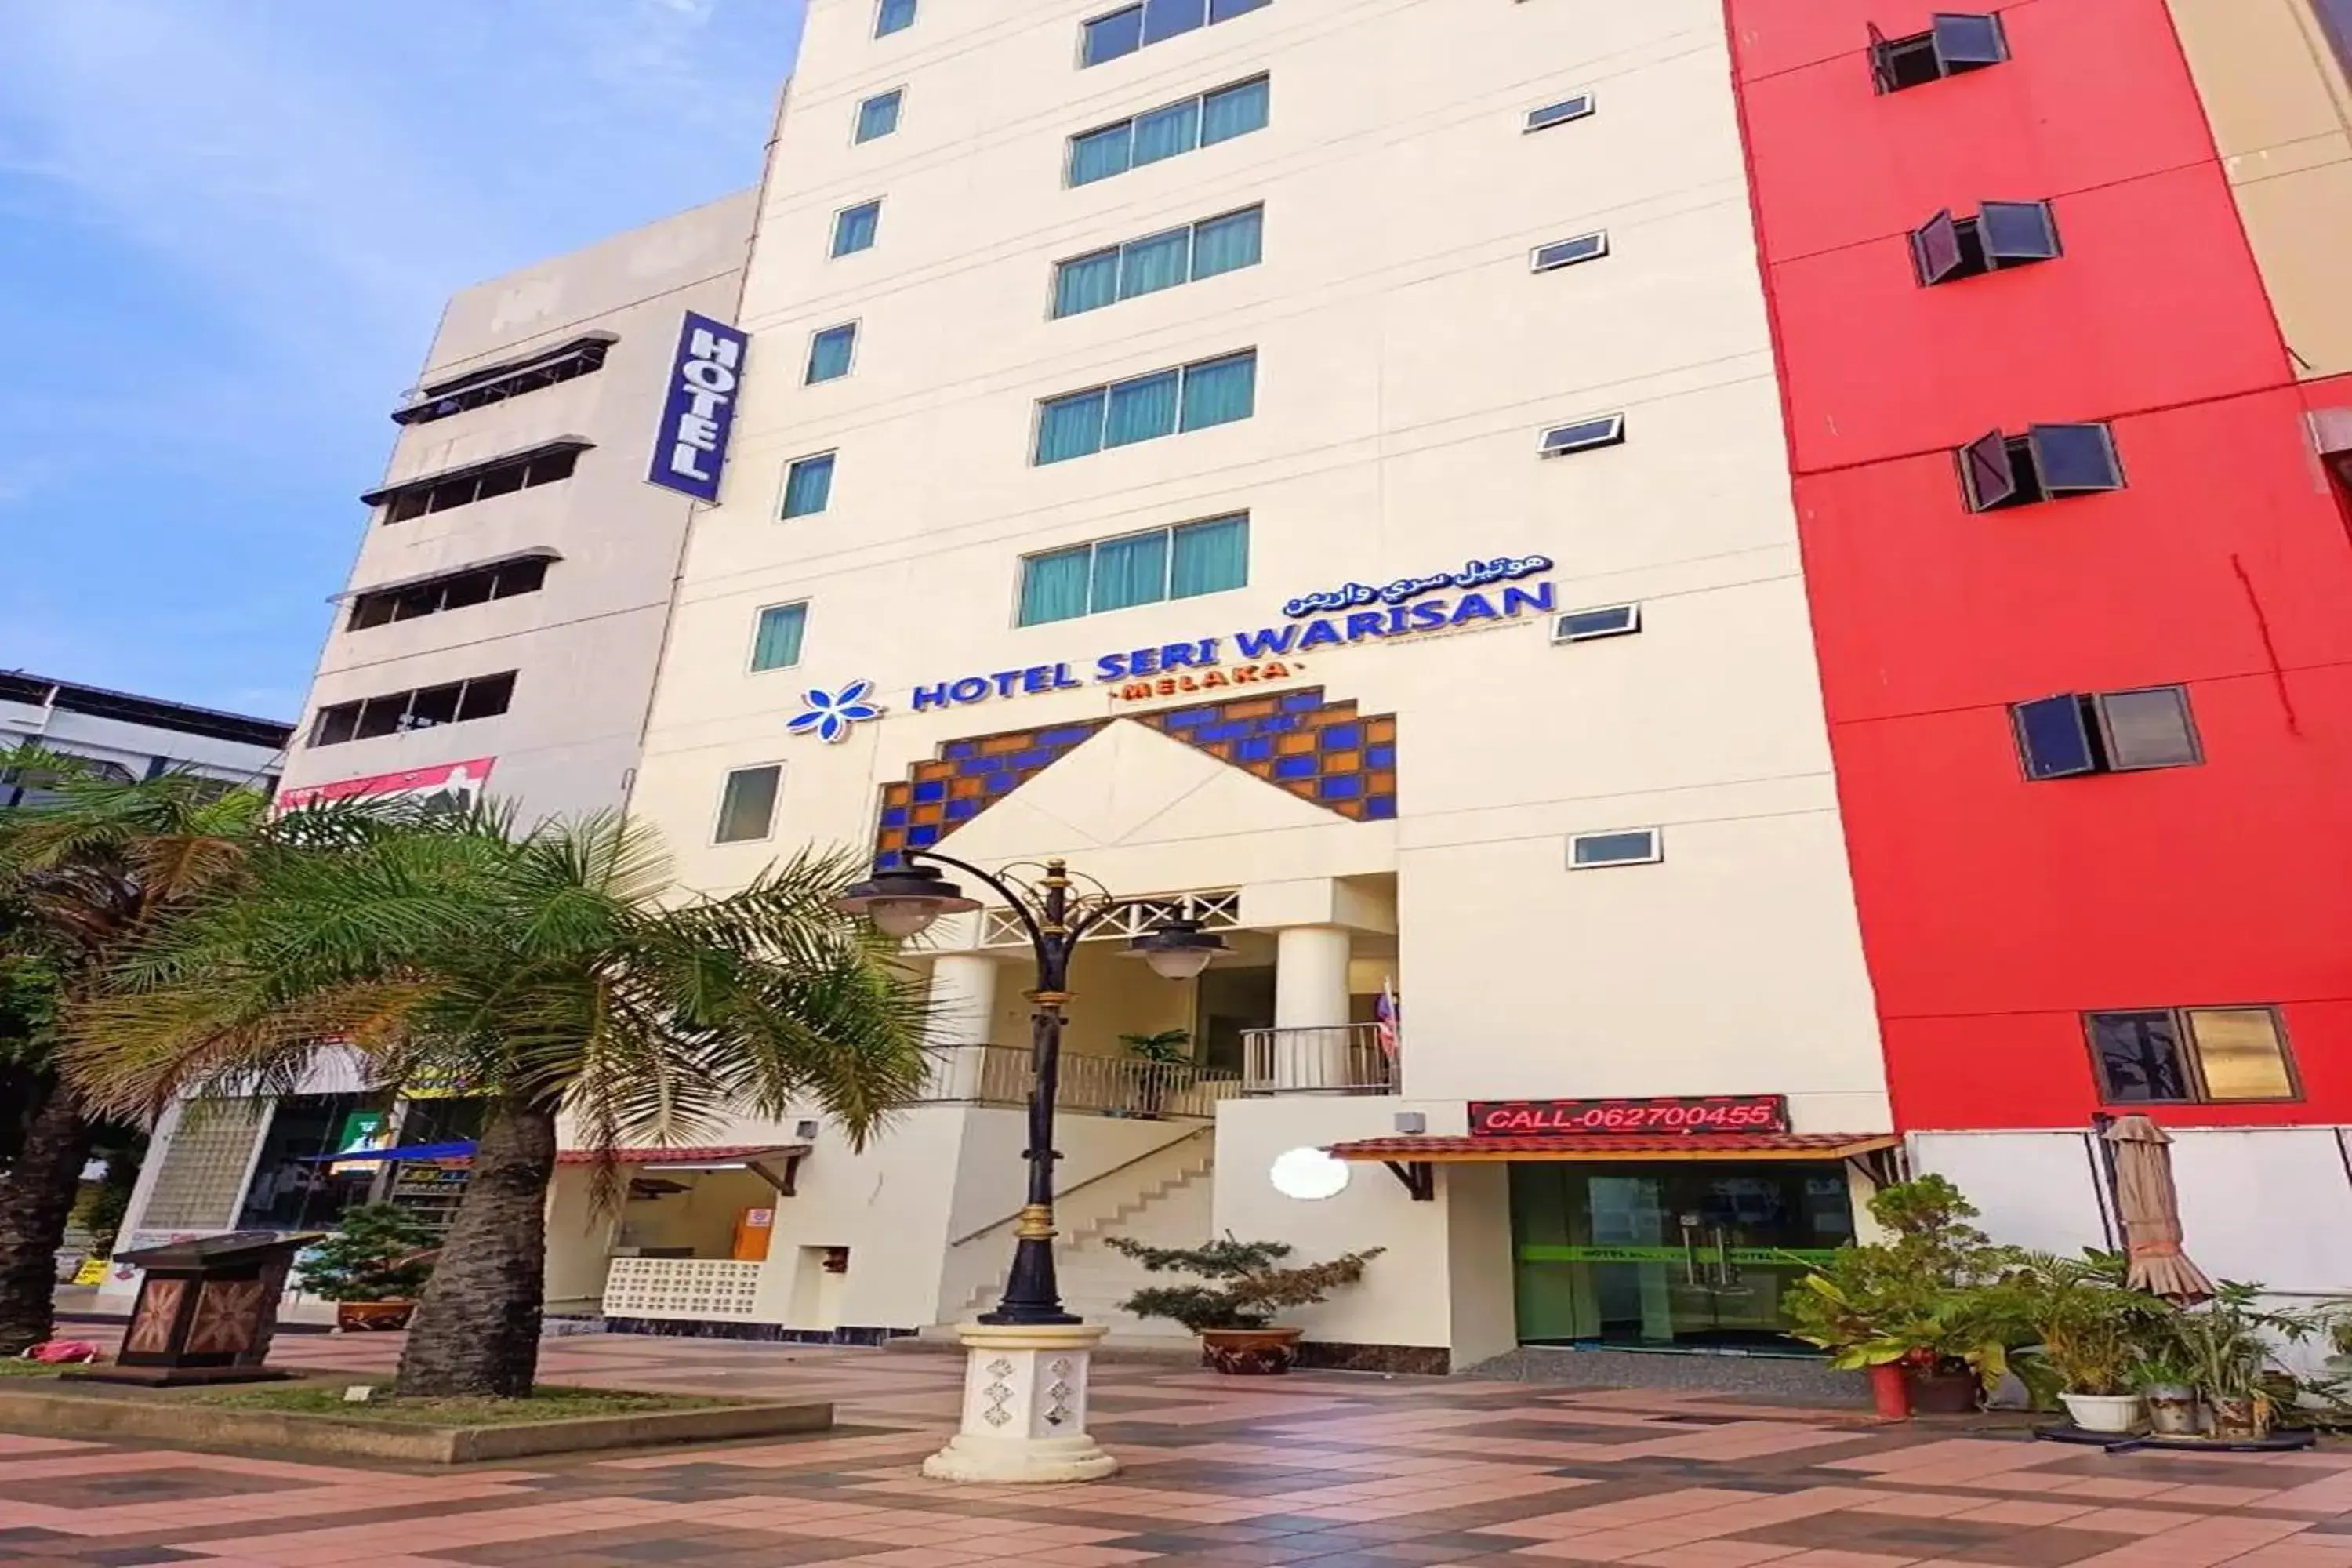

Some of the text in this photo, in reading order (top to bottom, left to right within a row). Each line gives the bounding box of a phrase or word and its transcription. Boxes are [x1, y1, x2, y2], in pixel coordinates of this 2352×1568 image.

[670, 328, 739, 481] HOTEL
[911, 582, 1557, 712] HOTEL SERI WARISAN
[1120, 661, 1290, 701] MELAKA
[1486, 1105, 1773, 1129] CALL-062700455
